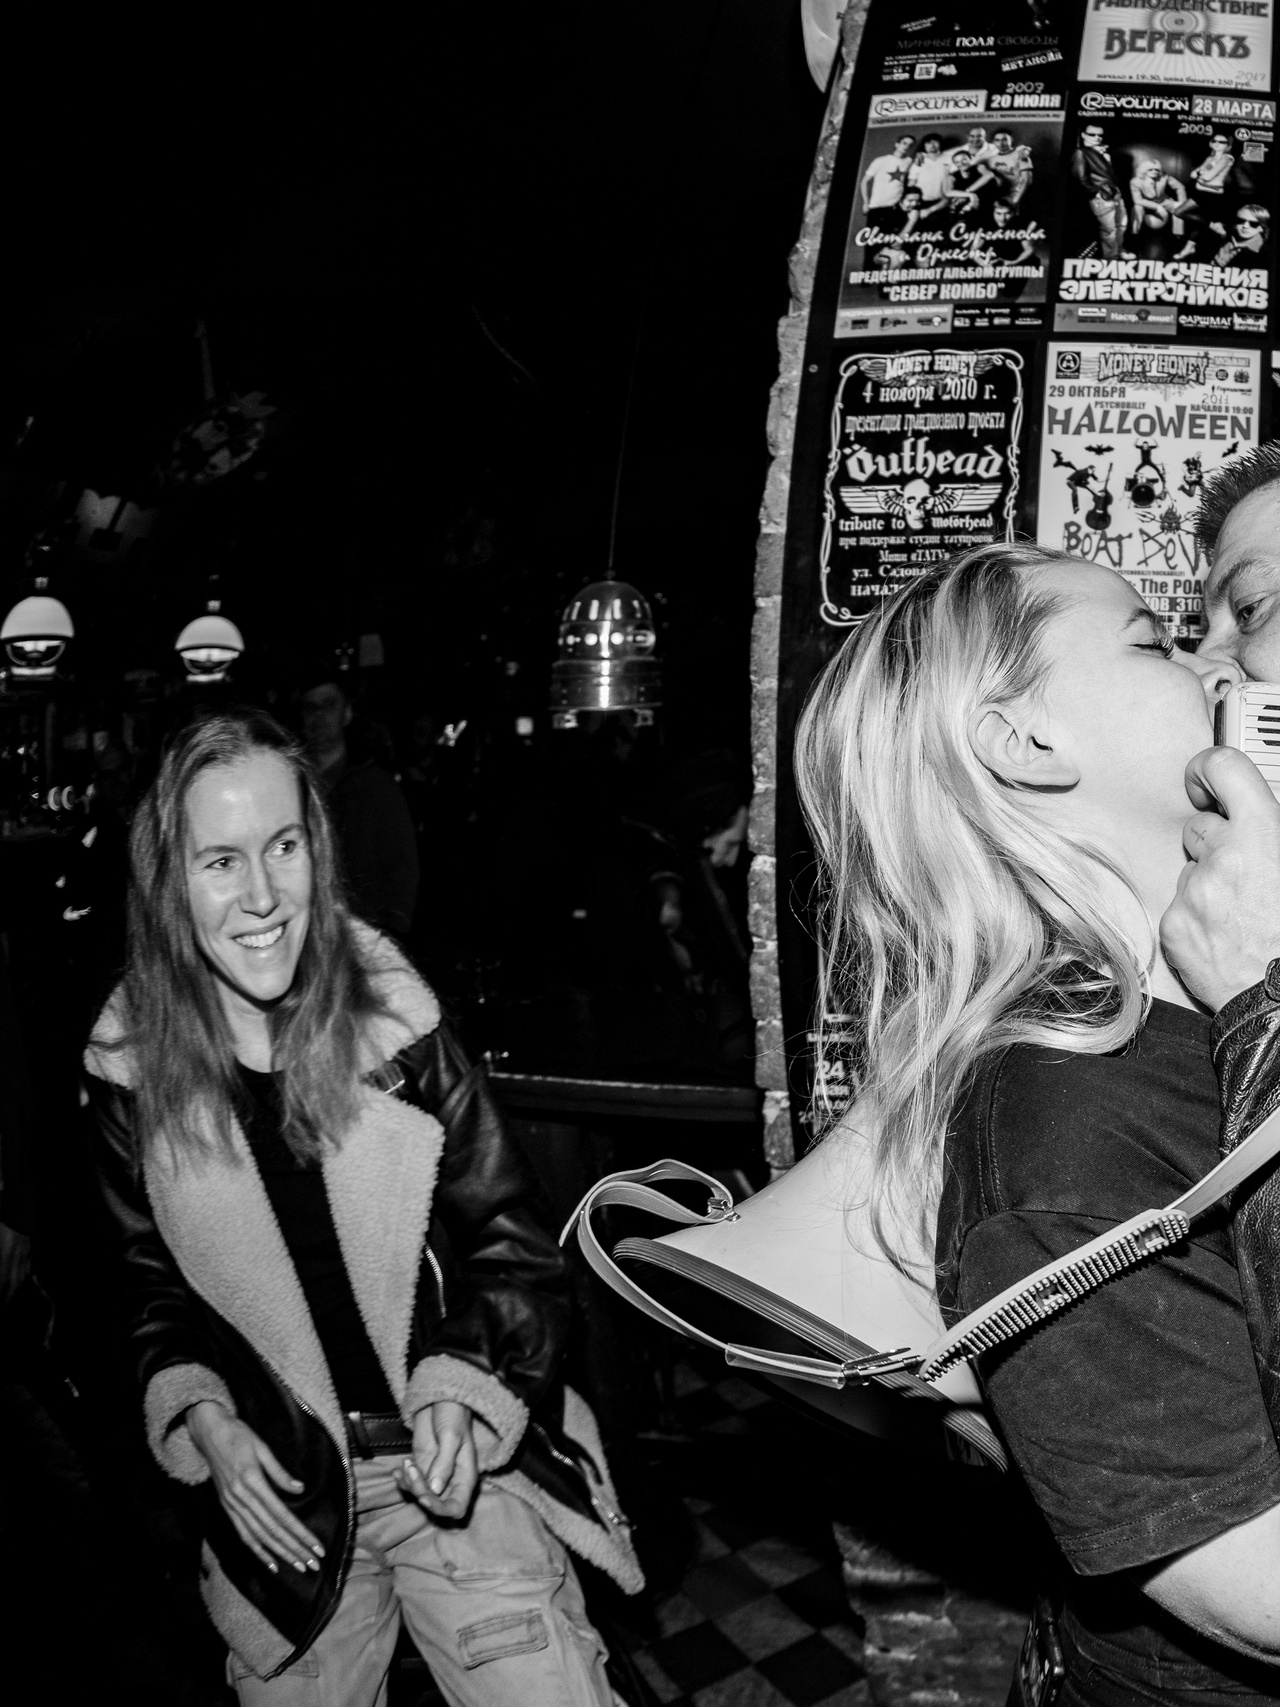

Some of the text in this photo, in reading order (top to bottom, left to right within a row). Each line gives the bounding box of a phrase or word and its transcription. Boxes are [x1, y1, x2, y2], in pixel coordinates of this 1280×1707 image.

[955, 36, 994, 47] ПОЛЯ
[990, 94, 1012, 109] 20
[1080, 92, 1190, 111] REVOLUTION
[1194, 98, 1274, 119] 28 МАРТА
[849, 267, 942, 284] ПРЕДСТАВЛЯЮТ
[943, 266, 994, 280] АЛЬБОМ
[1062, 257, 1268, 290] ПРИКЛЮЧЕНИЯ
[1059, 279, 1269, 310] ЭЛЕКТРОНИКОВ
[885, 354, 978, 380] MONEY HONEY
[1098, 352, 1208, 385] MONEY HONEY
[862, 381, 874, 404] 4
[941, 378, 978, 401] 2010
[984, 384, 997, 400] г.
[1049, 385, 1126, 398] 29 ОКТЯБРЯ
[1094, 401, 1147, 410] PSYCHOBILLY
[1190, 404, 1223, 413] НАЧАЛО
[1233, 405, 1254, 414] 19:00
[1048, 403, 1251, 440] HALLOWEEN
[838, 516, 885, 532] tribute
[891, 517, 905, 530] to
[850, 584, 905, 597] начал
[1140, 578, 1204, 595] The POA
